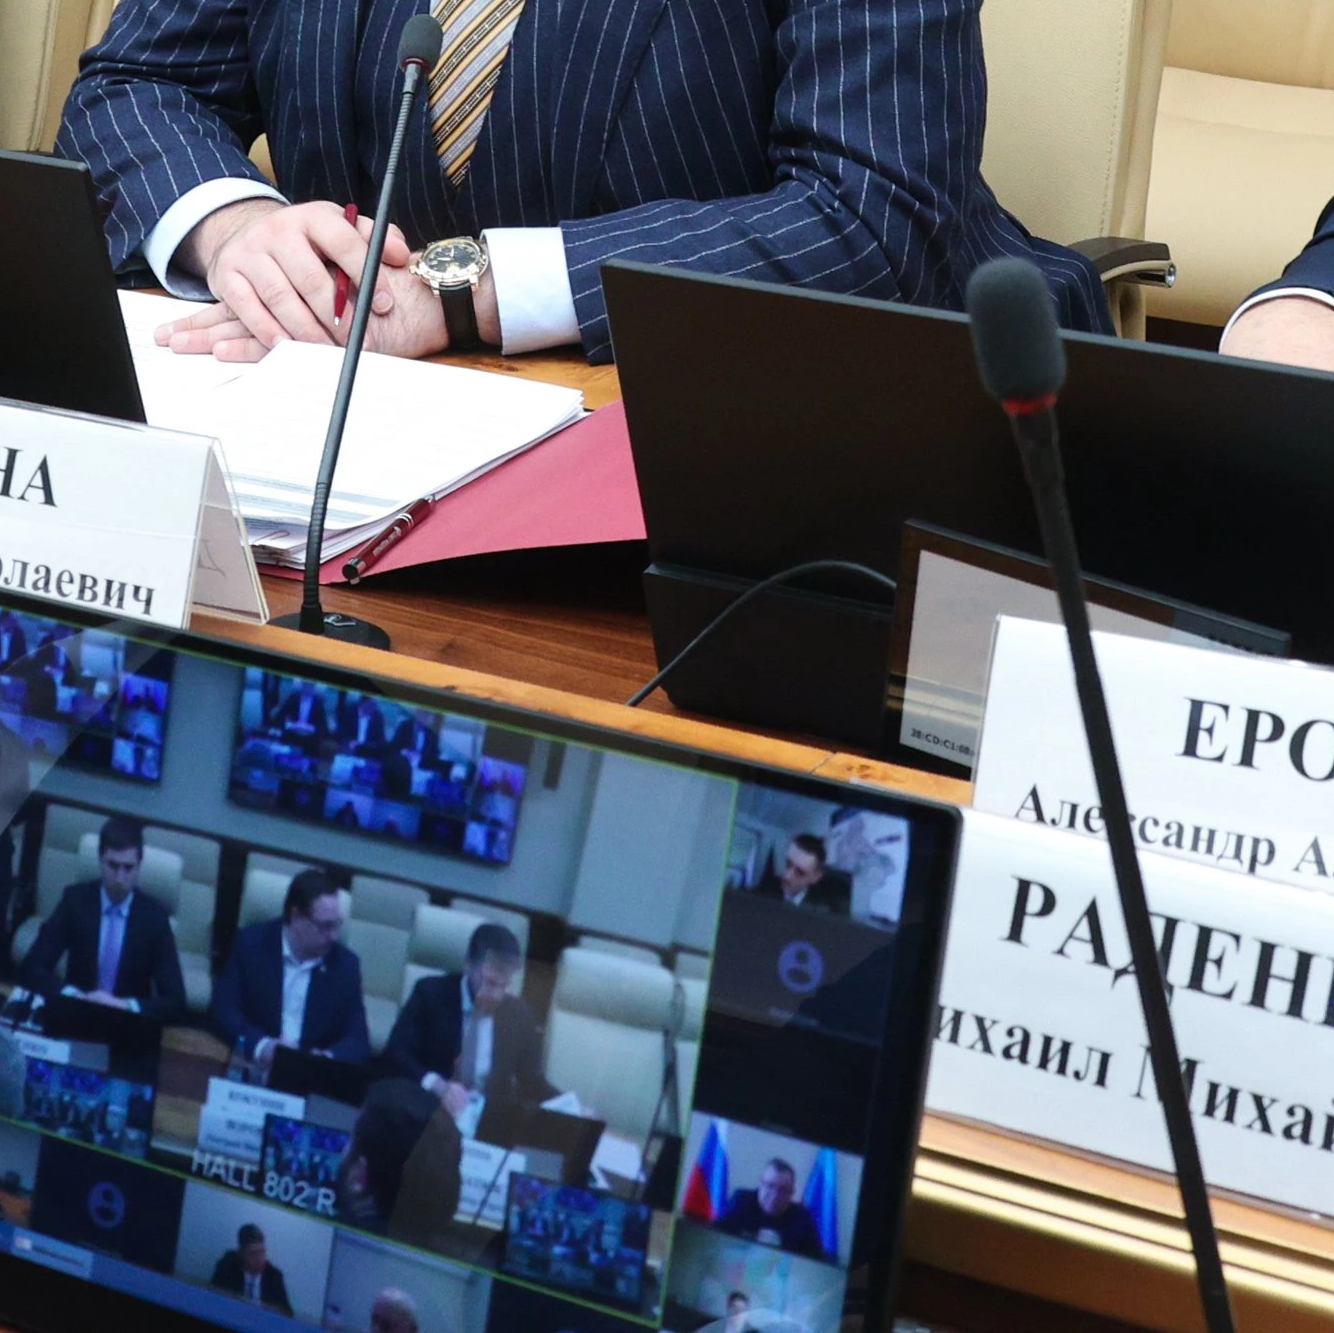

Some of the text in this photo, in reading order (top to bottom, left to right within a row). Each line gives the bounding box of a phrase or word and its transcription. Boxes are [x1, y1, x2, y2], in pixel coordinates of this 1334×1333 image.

[1014, 783, 1277, 874] Алесандр
[932, 1003, 1113, 1089] ихаил
[191, 1148, 337, 1216] HALL 802 R
